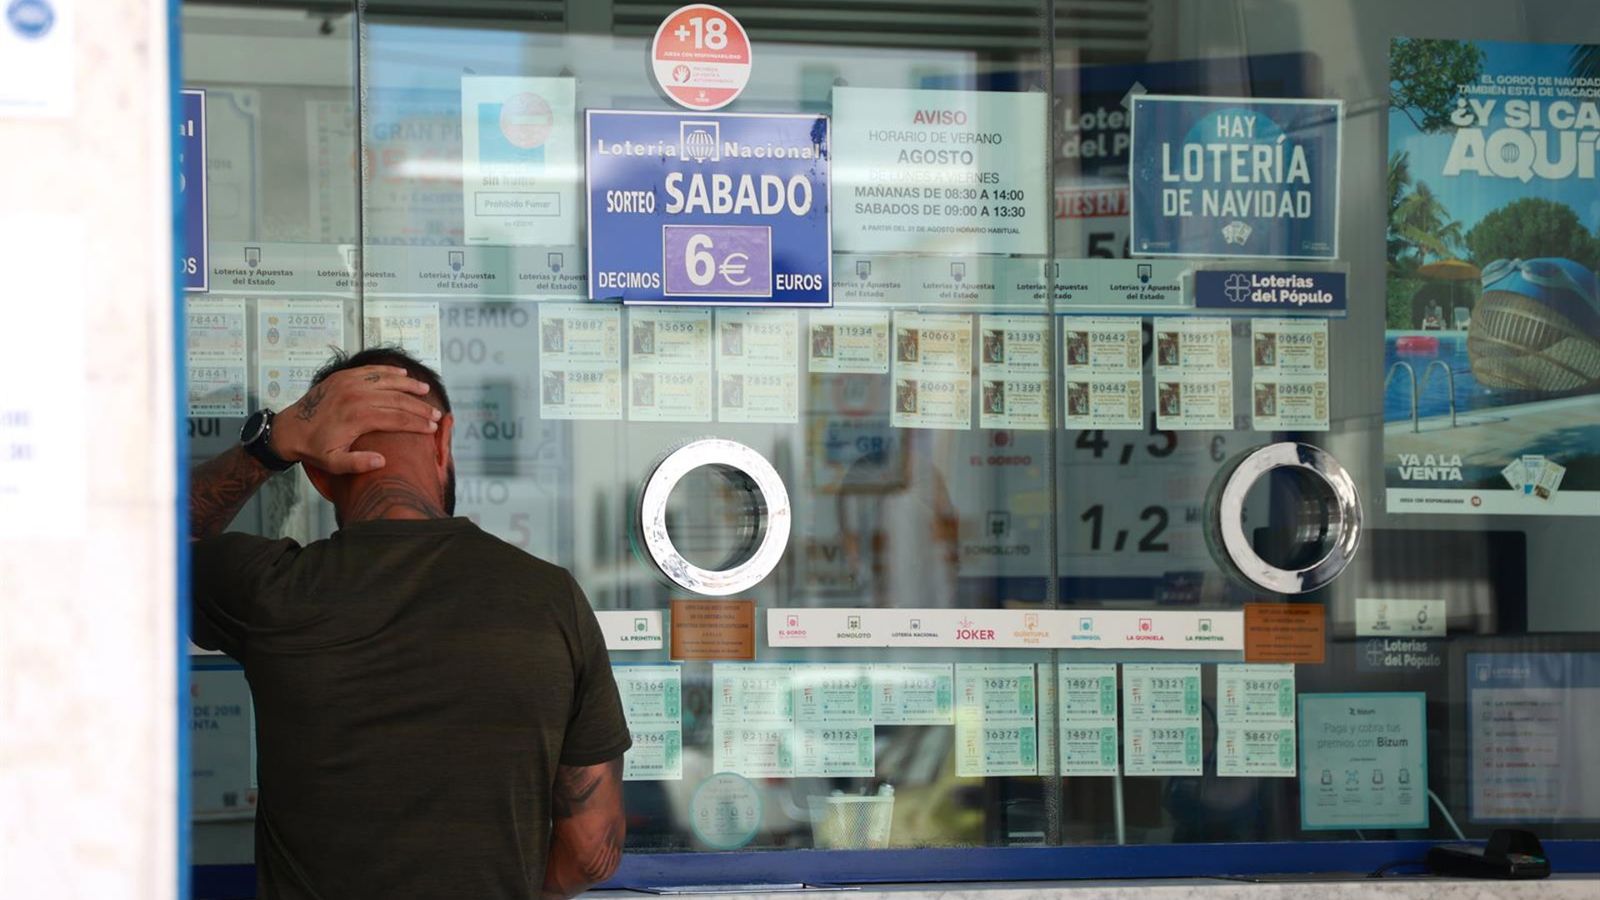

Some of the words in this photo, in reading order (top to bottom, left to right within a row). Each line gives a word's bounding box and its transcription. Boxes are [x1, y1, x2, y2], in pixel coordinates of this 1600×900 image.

[674, 17, 727, 50] +18
[1481, 75, 1495, 85] EL
[1497, 76, 1536, 86] GORDO
[1538, 77, 1553, 86] DE
[1554, 77, 1600, 87] NAVIDAD
[1539, 87, 1553, 97] DE
[913, 110, 967, 126] AVISO
[1450, 97, 1496, 128] ¿Y
[1504, 99, 1541, 129] SI
[1216, 115, 1257, 139] HAY
[869, 131, 927, 144] HORARIO
[930, 132, 949, 144] DE
[952, 133, 1002, 145] VERANO
[1061, 132, 1107, 158] del
[724, 141, 820, 161] Nacional
[1442, 128, 1600, 184] AQUÍ
[897, 149, 974, 166] AGOSTO
[1161, 133, 1312, 185] LOTERÍA
[946, 172, 1002, 185] VIERNES
[606, 189, 656, 214] SORTEO
[664, 172, 814, 217] SABADO
[854, 184, 921, 199] MAÑANAS
[923, 187, 942, 200] DE
[944, 188, 978, 201] 08:30
[979, 189, 990, 201] A
[993, 189, 1025, 202] 14:00
[485, 199, 523, 209] Prohibido
[1162, 188, 1193, 218] DE
[1202, 190, 1311, 219] NAVIDAD
[922, 204, 941, 216] DE
[944, 204, 978, 217] 09:00
[980, 205, 990, 217] A
[994, 205, 1027, 218] 13:30
[927, 226, 955, 234] AGOSTO
[956, 227, 987, 235] HORARIO
[988, 227, 1021, 235] HABITUAL
[256, 269, 293, 280] Apuestas
[458, 272, 497, 282] Apuestas
[233, 277, 247, 286] del
[248, 278, 276, 286] Estado
[335, 279, 349, 288] del
[437, 281, 449, 290] del
[450, 281, 479, 290] Estado
[536, 282, 548, 291] del
[549, 282, 578, 291] Estado
[598, 269, 661, 291] DECIMOS
[775, 273, 823, 294] EUROS
[865, 282, 902, 292] Apuestas
[961, 282, 997, 293] Apuestas
[1149, 284, 1182, 294] Apuestas
[858, 290, 885, 299] Estado
[939, 291, 951, 300] del
[952, 291, 979, 300] Estado
[1126, 292, 1139, 301] del
[1138, 292, 1166, 301] Estado
[1251, 288, 1277, 304] del
[1279, 288, 1333, 307] Pópulo
[287, 315, 327, 326] 20200
[838, 327, 880, 338] 11934
[1006, 331, 1043, 342] 21393
[1090, 332, 1127, 343] 90442
[1006, 382, 1043, 393] 21393
[1091, 383, 1128, 394] 90442
[1397, 453, 1421, 467] YA
[1424, 454, 1437, 467] A
[1439, 454, 1463, 467] LA
[1398, 467, 1464, 481] VENTA
[1079, 503, 1170, 553] 1,2
[836, 632, 872, 640] BONOLOTO
[956, 629, 996, 641] JOKER
[1125, 634, 1134, 642] LA
[1134, 634, 1165, 642] QUINIELA
[1383, 653, 1403, 667] del
[629, 681, 665, 692] 15164
[983, 680, 1018, 690] 16372
[1067, 680, 1100, 690] 14971
[1151, 679, 1184, 690] 13121
[1323, 722, 1349, 735] Paga
[1350, 726, 1356, 736] y
[1358, 722, 1385, 734] cobra
[823, 731, 858, 741] 61123
[985, 731, 1020, 741] 16372
[1067, 731, 1101, 741] 14971
[1152, 730, 1185, 741] 13121
[1377, 736, 1409, 749] Bizum
